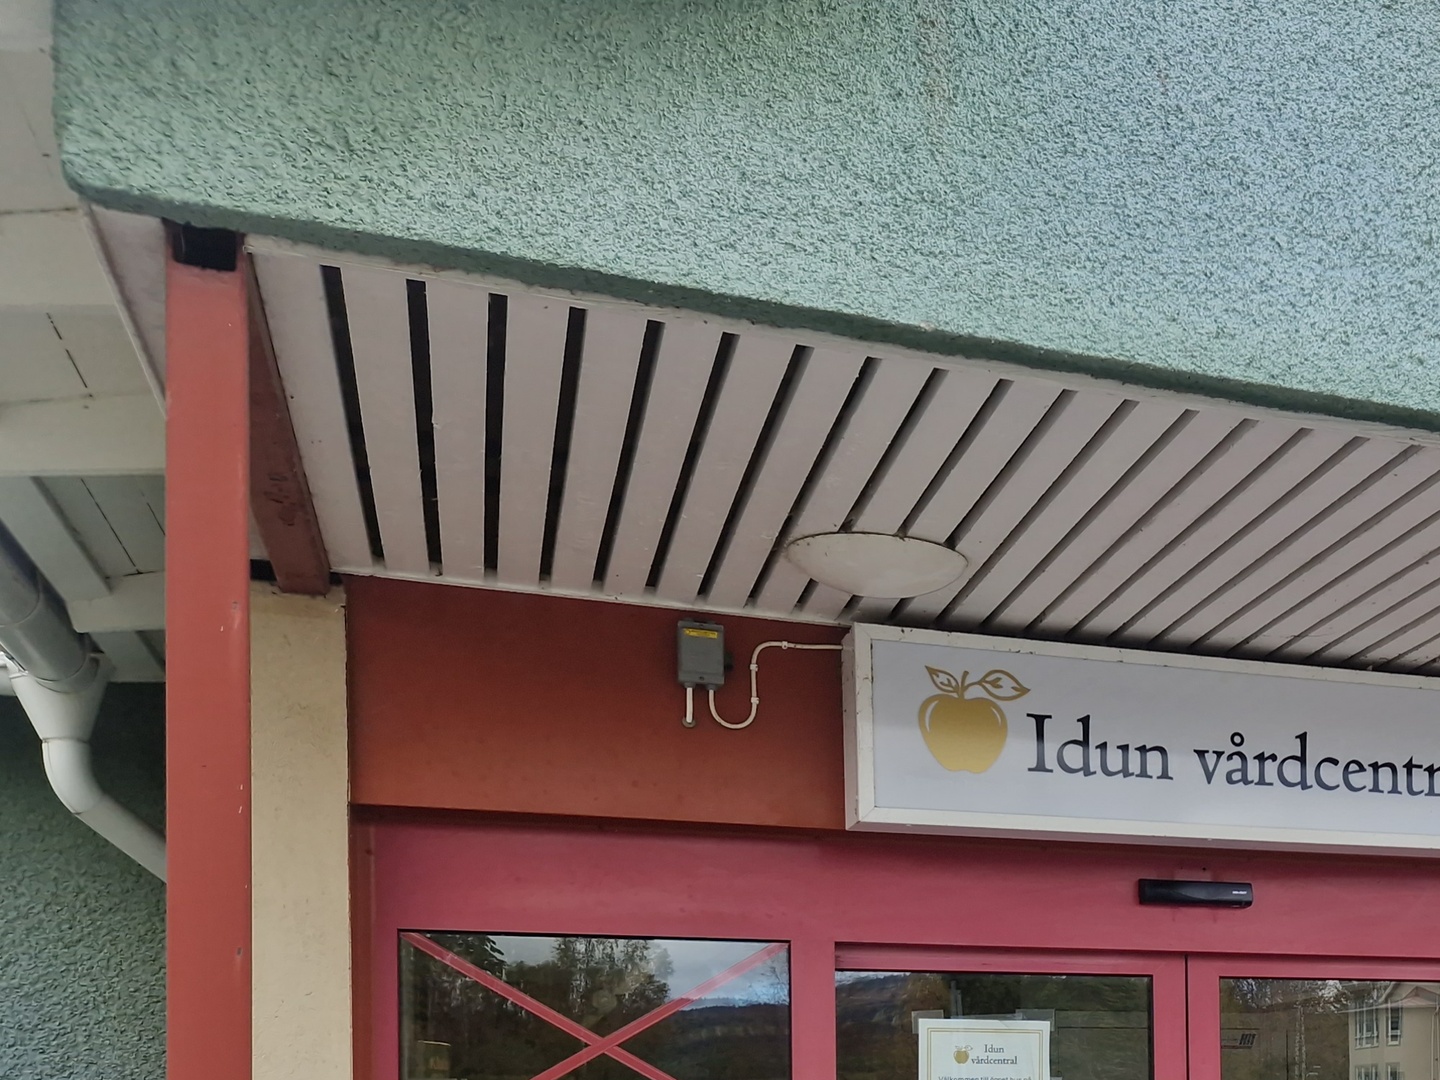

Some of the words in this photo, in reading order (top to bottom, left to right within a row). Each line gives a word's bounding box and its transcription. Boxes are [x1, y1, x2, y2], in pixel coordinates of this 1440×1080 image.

[1026, 711, 1173, 781] Idun
[984, 1044, 1004, 1053] Idun
[971, 1055, 1017, 1064] vårdcentral
